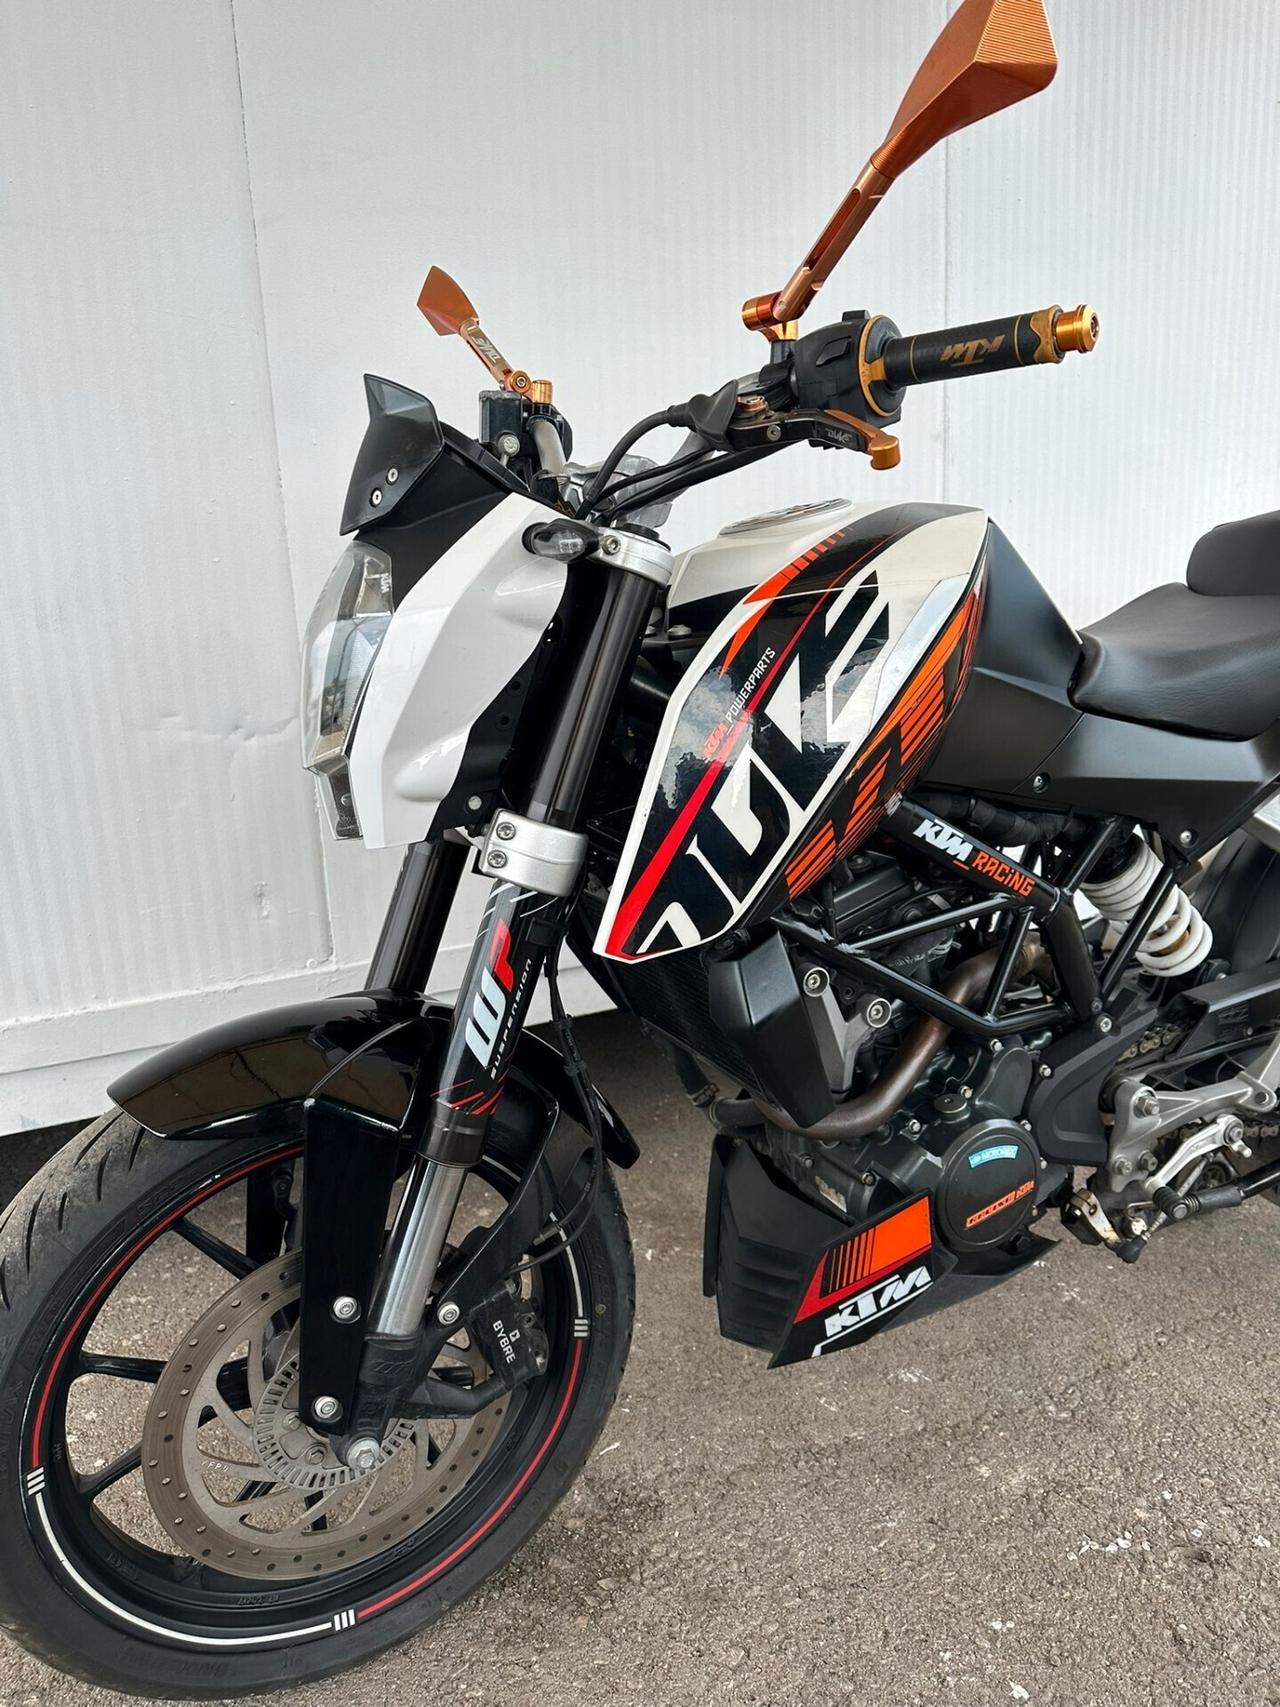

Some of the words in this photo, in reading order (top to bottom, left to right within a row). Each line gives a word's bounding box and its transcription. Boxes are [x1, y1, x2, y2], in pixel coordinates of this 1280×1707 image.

[940, 334, 1005, 367] KTM
[725, 646, 776, 724] POWERPARTS
[912, 818, 975, 862] KTM
[824, 1265, 932, 1338] KTM
[492, 1319, 516, 1365] BYBRE
